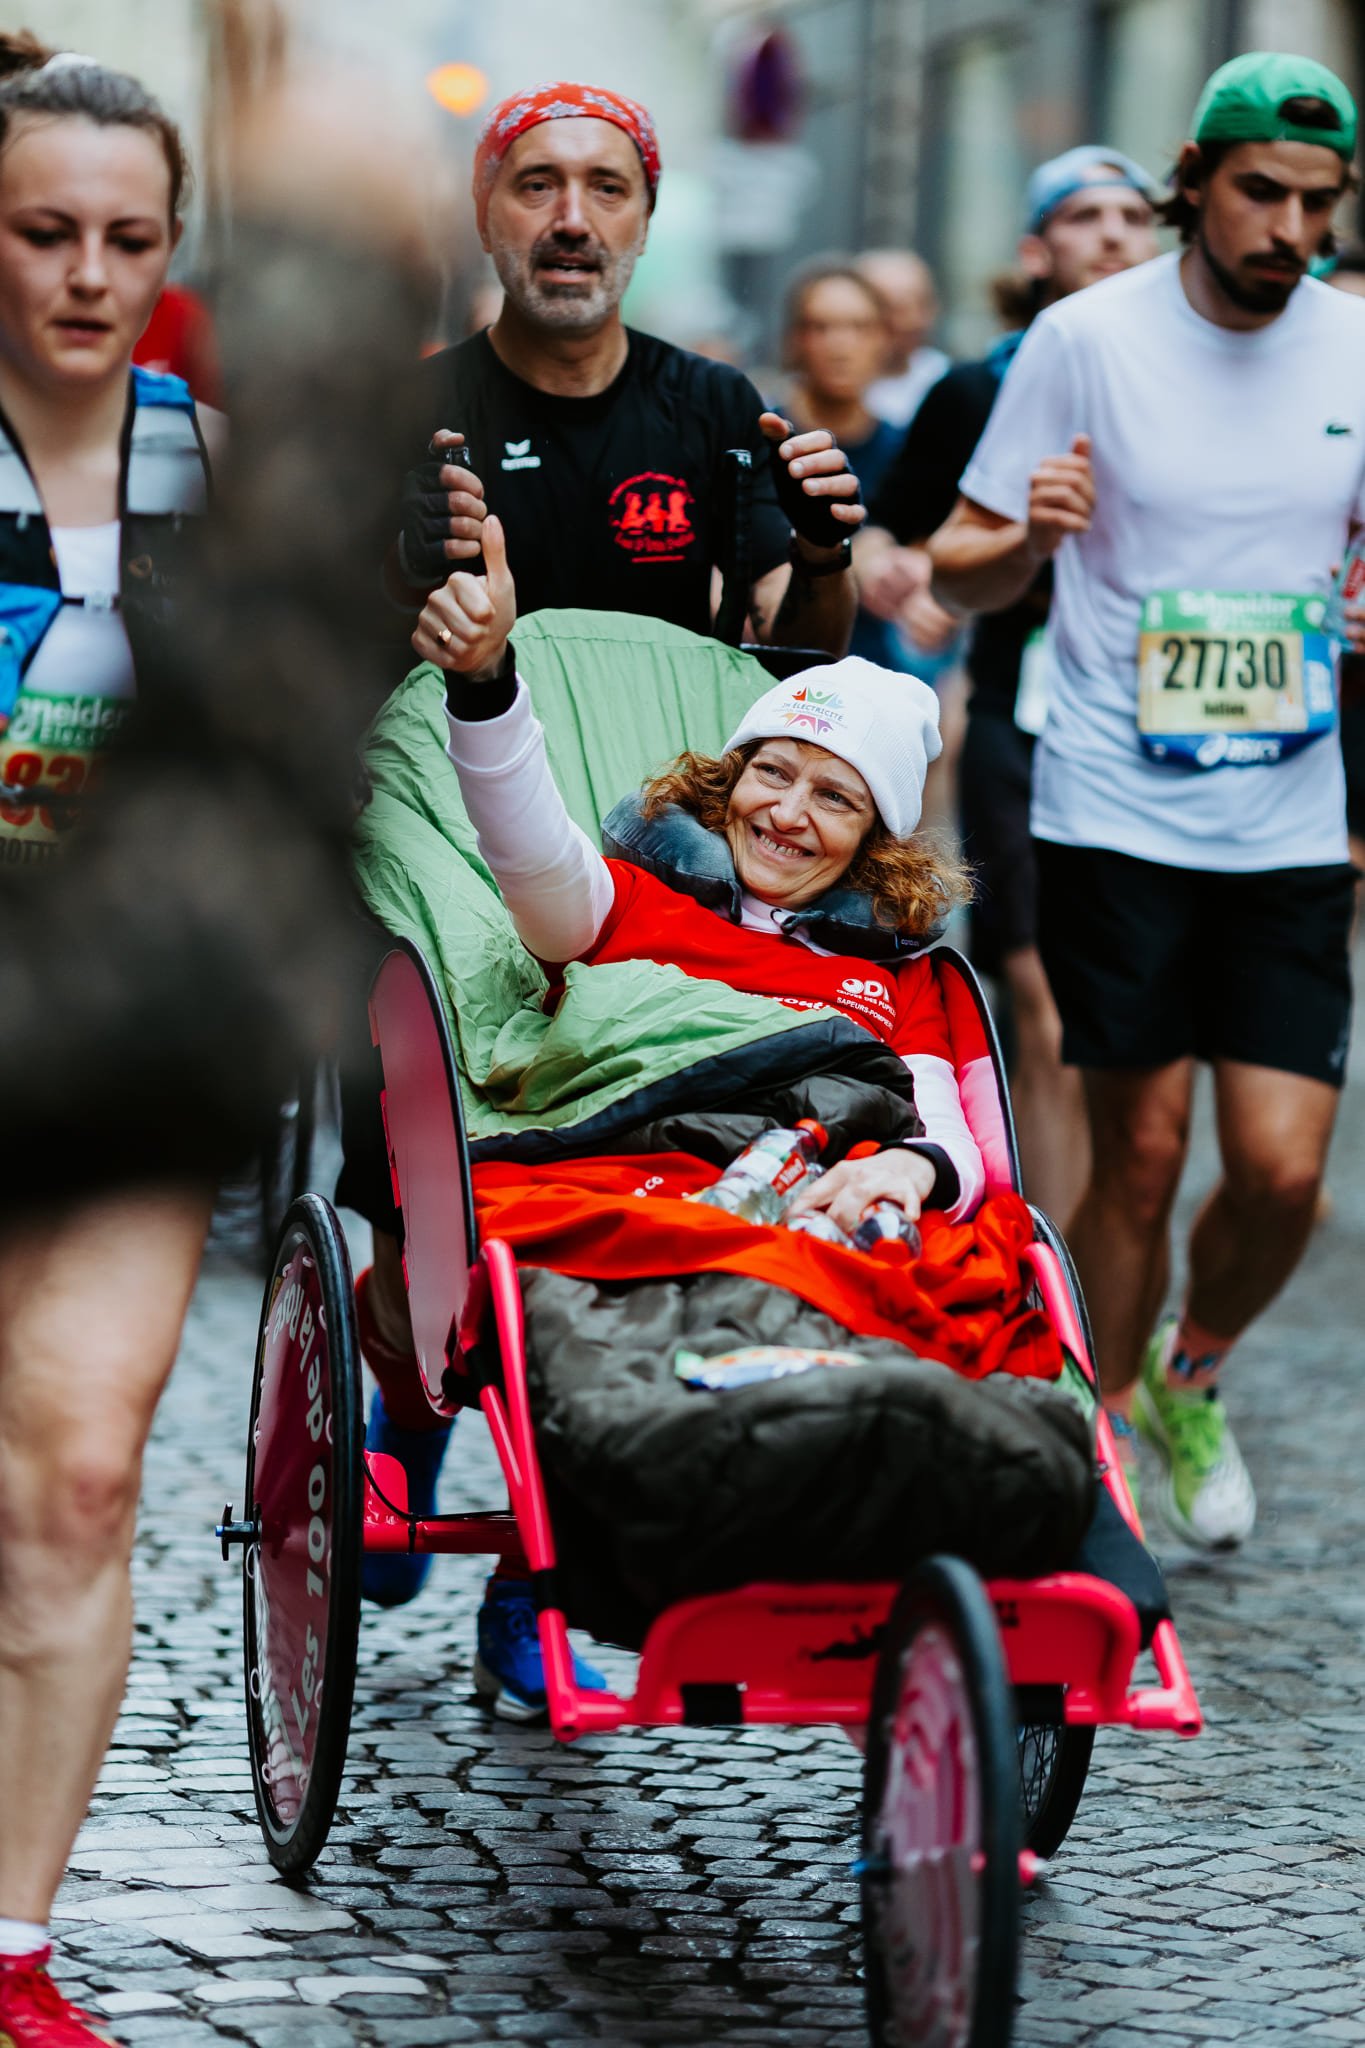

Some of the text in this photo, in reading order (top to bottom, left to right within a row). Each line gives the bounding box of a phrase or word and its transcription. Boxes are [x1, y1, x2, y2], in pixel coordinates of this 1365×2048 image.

[1162, 637, 1287, 690] 27730
[305, 1353, 324, 1443] de
[306, 1463, 326, 1598] 100
